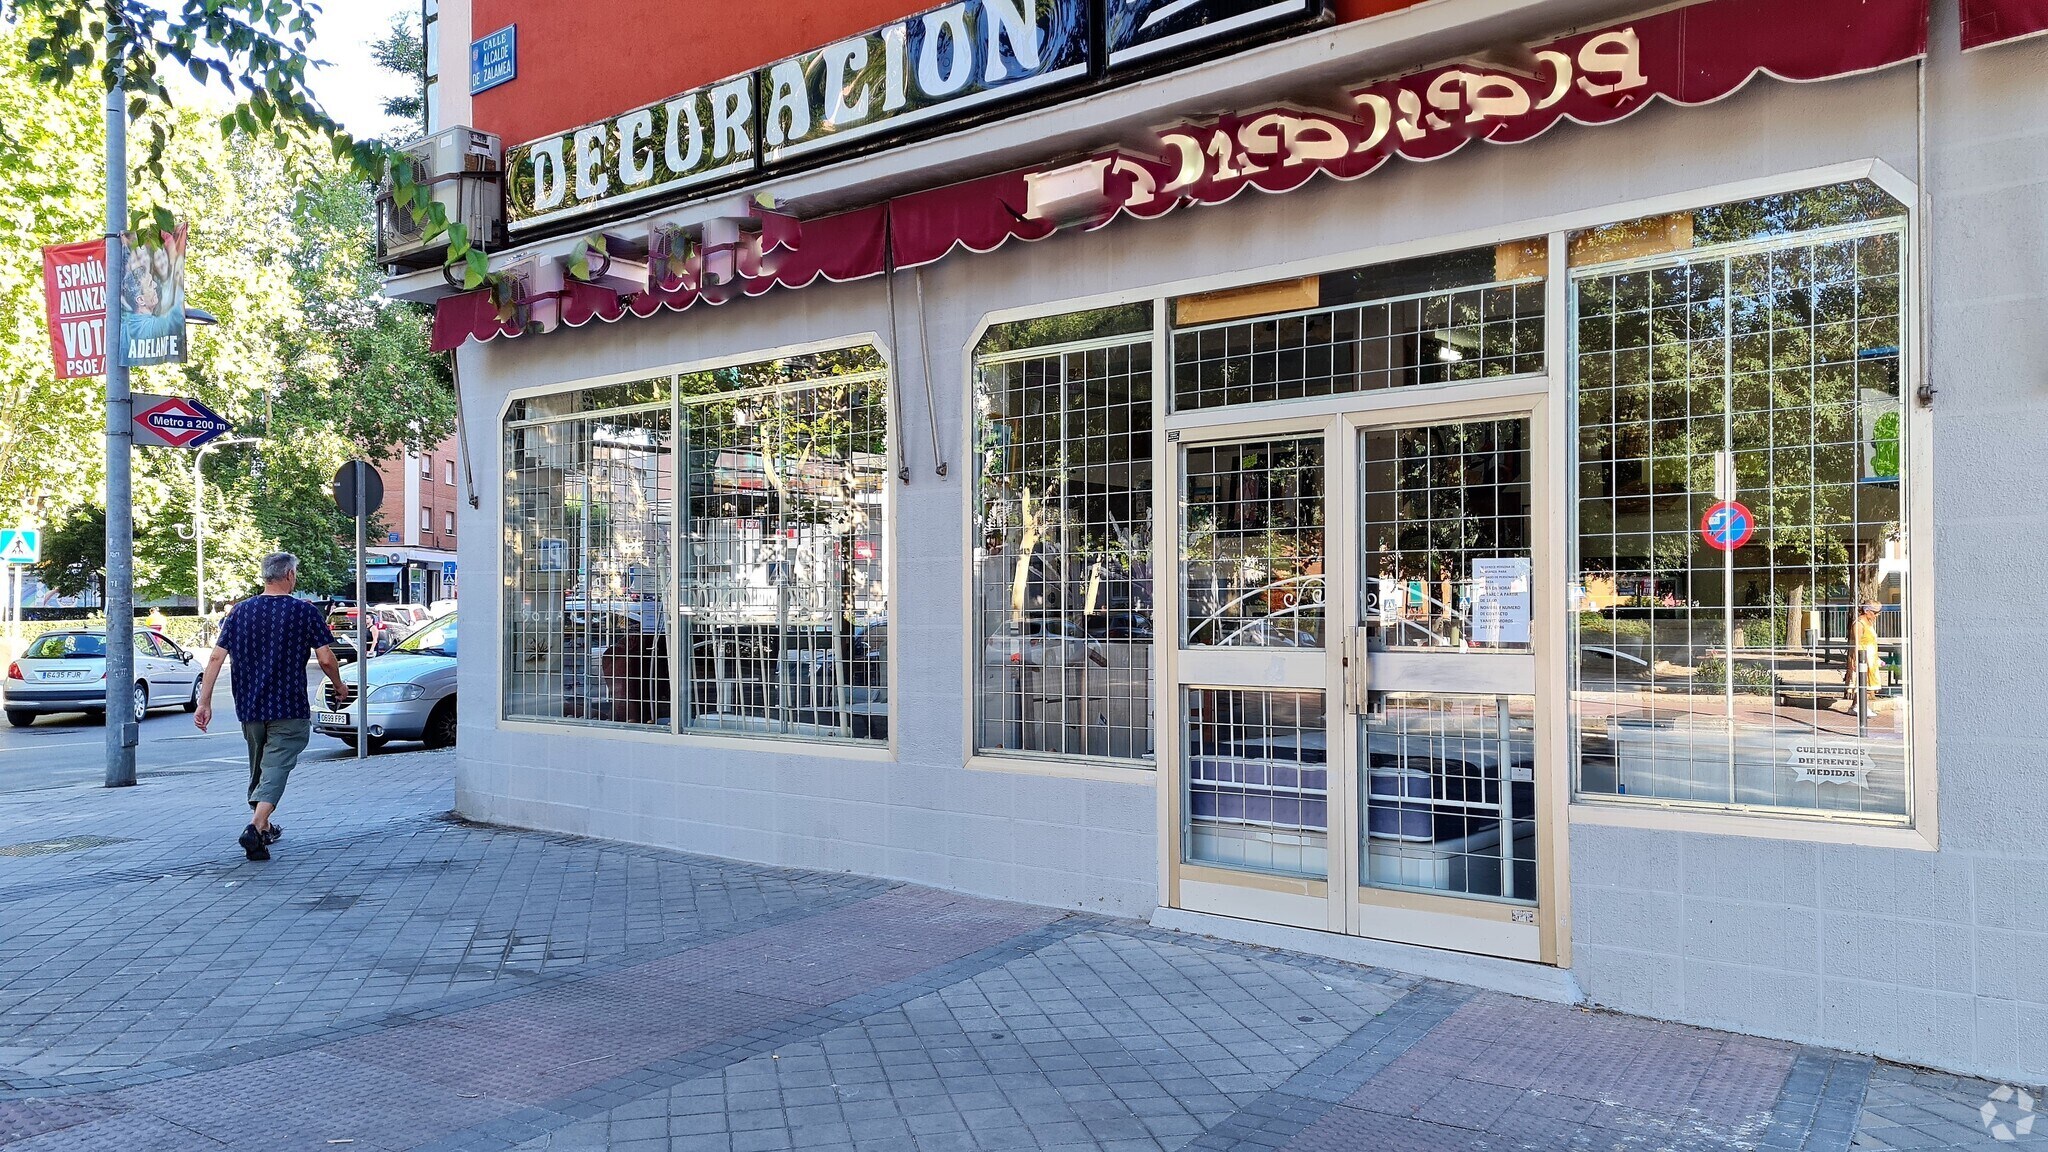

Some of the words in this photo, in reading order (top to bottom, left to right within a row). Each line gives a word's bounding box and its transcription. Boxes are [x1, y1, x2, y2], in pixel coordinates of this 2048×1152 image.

[483, 33, 506, 51] CALLE
[483, 45, 509, 67] ALCALDE
[473, 72, 480, 87] DE
[484, 60, 511, 82] ZALAMEA
[530, 0, 1042, 211] DECORACION
[55, 255, 106, 288] ESPAÑA
[60, 286, 106, 314] AVANZA
[128, 335, 179, 358] ADELANTE
[66, 359, 99, 375] PSOE
[153, 416, 184, 427] Metro
[186, 420, 193, 428] a
[195, 420, 214, 429] 200
[46, 671, 65, 679] 6435
[67, 671, 82, 679] FJR
[1796, 746, 1865, 756] CUBERTEROS
[1798, 757, 1864, 767] DIFERENTES
[1806, 768, 1856, 777] MEDIDAS
